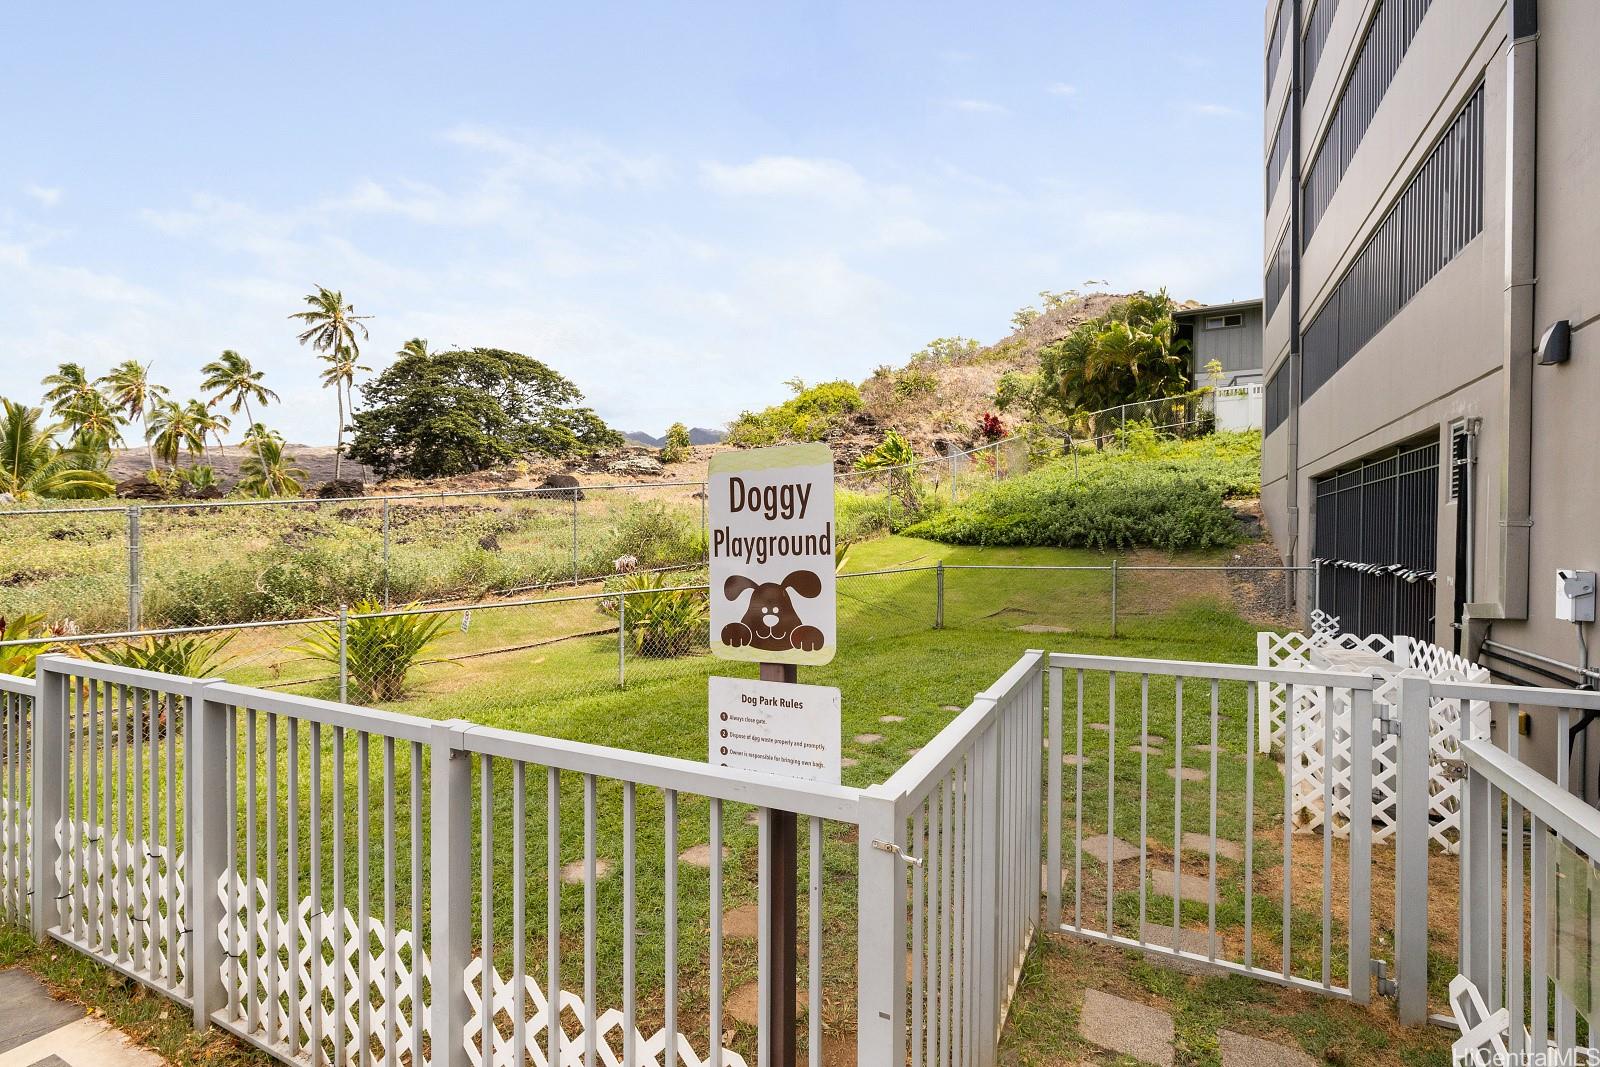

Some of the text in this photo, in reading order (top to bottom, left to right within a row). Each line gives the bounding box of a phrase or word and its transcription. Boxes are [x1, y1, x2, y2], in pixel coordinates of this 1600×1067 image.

[729, 476, 812, 520] Doggy
[714, 522, 831, 564] Playground
[741, 694, 803, 709] Dog Park Rules
[774, 739, 793, 747] properly
[749, 752, 773, 761] responsible
[781, 756, 800, 766] bringing
